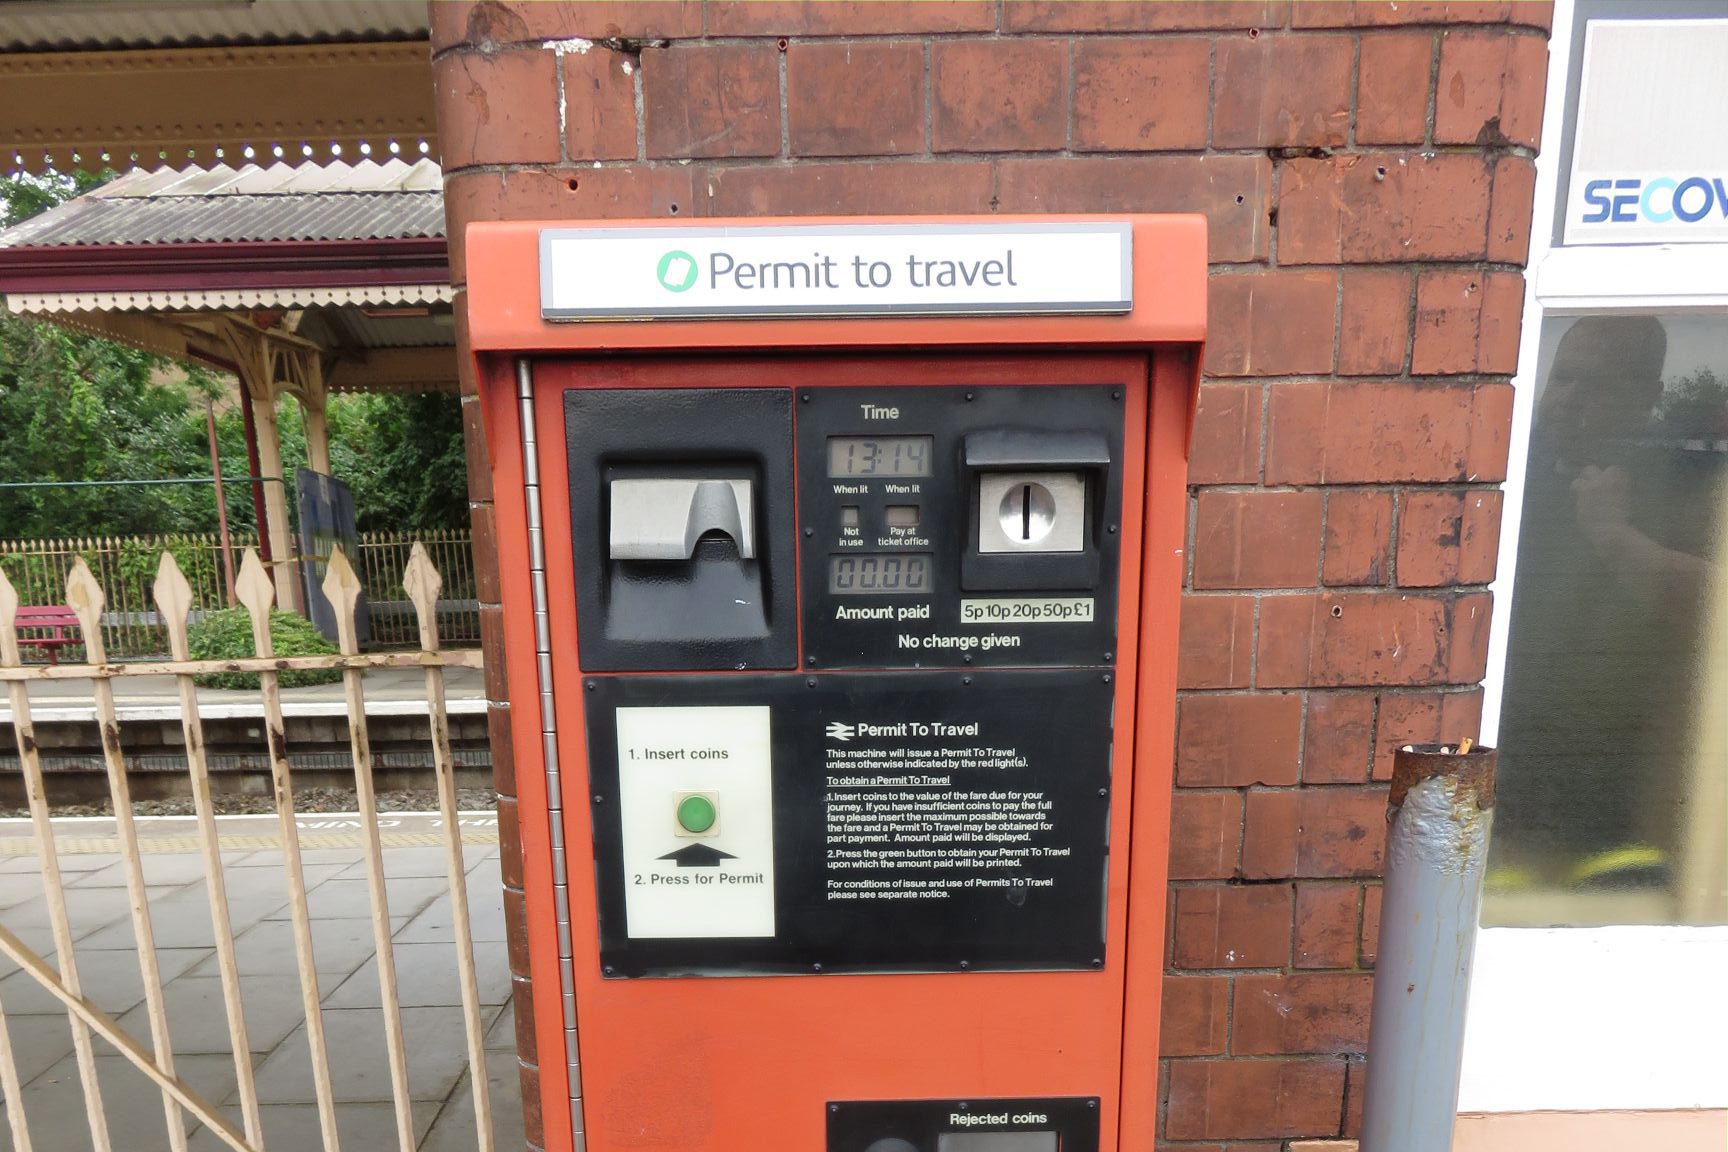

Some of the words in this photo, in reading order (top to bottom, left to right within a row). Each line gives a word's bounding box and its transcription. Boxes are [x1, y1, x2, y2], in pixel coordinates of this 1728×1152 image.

[710, 252, 839, 290] Permit
[851, 255, 892, 288] to
[905, 250, 1017, 287] travel
[861, 405, 900, 419] Time
[847, 442, 922, 473] 13:14
[833, 485, 858, 494] When
[859, 485, 868, 494] lit
[885, 484, 910, 494] When
[912, 484, 920, 493] lit
[844, 527, 859, 536] Not
[890, 526, 905, 537] Pay
[907, 526, 916, 535] at
[839, 538, 847, 546] in
[878, 537, 902, 546] ticket
[904, 537, 929, 545] office
[836, 606, 893, 619] Amount
[898, 604, 929, 620] paid
[898, 634, 920, 649] No
[922, 634, 978, 651] change
[981, 633, 1021, 650] given
[858, 723, 907, 737] Permit
[909, 722, 929, 736] To
[931, 722, 978, 736] Travel
[629, 749, 640, 760] 1.
[645, 748, 685, 760] Insert
[690, 748, 729, 759] coins
[826, 749, 846, 758] This
[848, 749, 887, 758] machine
[889, 748, 905, 758] will
[907, 748, 932, 757] issue
[941, 748, 971, 757] Permit
[973, 748, 985, 757] To
[986, 748, 1015, 757] Travel
[826, 760, 856, 769] unless
[857, 760, 903, 768] otherwise
[905, 759, 947, 768] indicated
[949, 759, 960, 769] by
[961, 759, 976, 768] the
[978, 758, 993, 768] red
[995, 757, 1028, 769] light(s).
[826, 776, 839, 785] To
[840, 776, 868, 785] obtain
[877, 776, 907, 784] Permit
[908, 775, 921, 784] To
[922, 775, 950, 784] Travel
[863, 792, 887, 801] coins
[889, 792, 899, 801] to
[900, 792, 914, 800] the
[916, 792, 940, 800] value
[942, 791, 952, 800] of
[954, 791, 968, 800] the
[970, 791, 987, 799] fare
[989, 791, 1006, 799] due
[1008, 791, 1021, 799] for
[1023, 792, 1043, 801] your
[827, 803, 863, 813] journey.
[866, 802, 873, 811] If
[874, 803, 890, 812] you
[892, 802, 913, 811] have
[915, 802, 964, 810] insufficient
[966, 801, 990, 810] coins
[992, 801, 1001, 809] to
[1003, 803, 1020, 811] pay
[1021, 801, 1036, 809] the
[1038, 801, 1052, 809] full
[827, 813, 845, 822] fare
[847, 813, 877, 823] please
[879, 813, 905, 821] insert
[906, 812, 921, 821] the
[923, 812, 967, 821] maximum
[969, 812, 1007, 822] possible
[1009, 811, 1046, 820] towards
[827, 824, 842, 832] the
[844, 824, 862, 832] fare
[864, 823, 880, 832] and
[890, 823, 920, 832] Permit
[921, 823, 933, 831] To
[934, 823, 962, 831] Travel
[964, 824, 983, 833] may
[985, 822, 996, 831] be
[998, 822, 1038, 830] obtained
[1040, 822, 1053, 830] for
[827, 834, 847, 844] part
[848, 834, 891, 844] payment.
[894, 833, 930, 842] Amount
[932, 833, 952, 843] paid
[954, 833, 970, 841] will
[972, 833, 983, 841] be
[985, 832, 1031, 843] displayed.
[863, 849, 877, 858] the
[879, 850, 905, 859] green
[906, 849, 936, 857] button
[938, 848, 946, 857] to
[948, 848, 976, 857] obtain
[978, 849, 998, 858] your
[1000, 848, 1029, 857] Permit
[1030, 848, 1042, 856] To
[1043, 847, 1070, 856] Travel
[827, 862, 850, 870] upon
[852, 860, 879, 868] which
[881, 860, 894, 868] the
[896, 859, 931, 868] amount
[933, 859, 953, 869] paid
[955, 859, 971, 867] will
[973, 859, 984, 867] be
[986, 858, 1022, 868] printed.
[634, 875, 646, 885] 2.
[651, 874, 690, 885] Press
[695, 873, 714, 885] for
[719, 873, 764, 884] Permit
[827, 880, 842, 889] For
[844, 880, 890, 888] conditions
[892, 880, 902, 888] of
[903, 879, 926, 888] issue
[928, 879, 945, 888] and
[964, 879, 974, 887] of
[976, 878, 1010, 887] Permits
[1012, 878, 1024, 887] To
[1025, 878, 1053, 886] Travel
[828, 891, 857, 900] please
[859, 891, 876, 899] see
[878, 890, 917, 900] separate
[919, 890, 950, 898] notice.
[950, 1113, 1008, 1127] Rejected
[1012, 1112, 1048, 1124] coins
